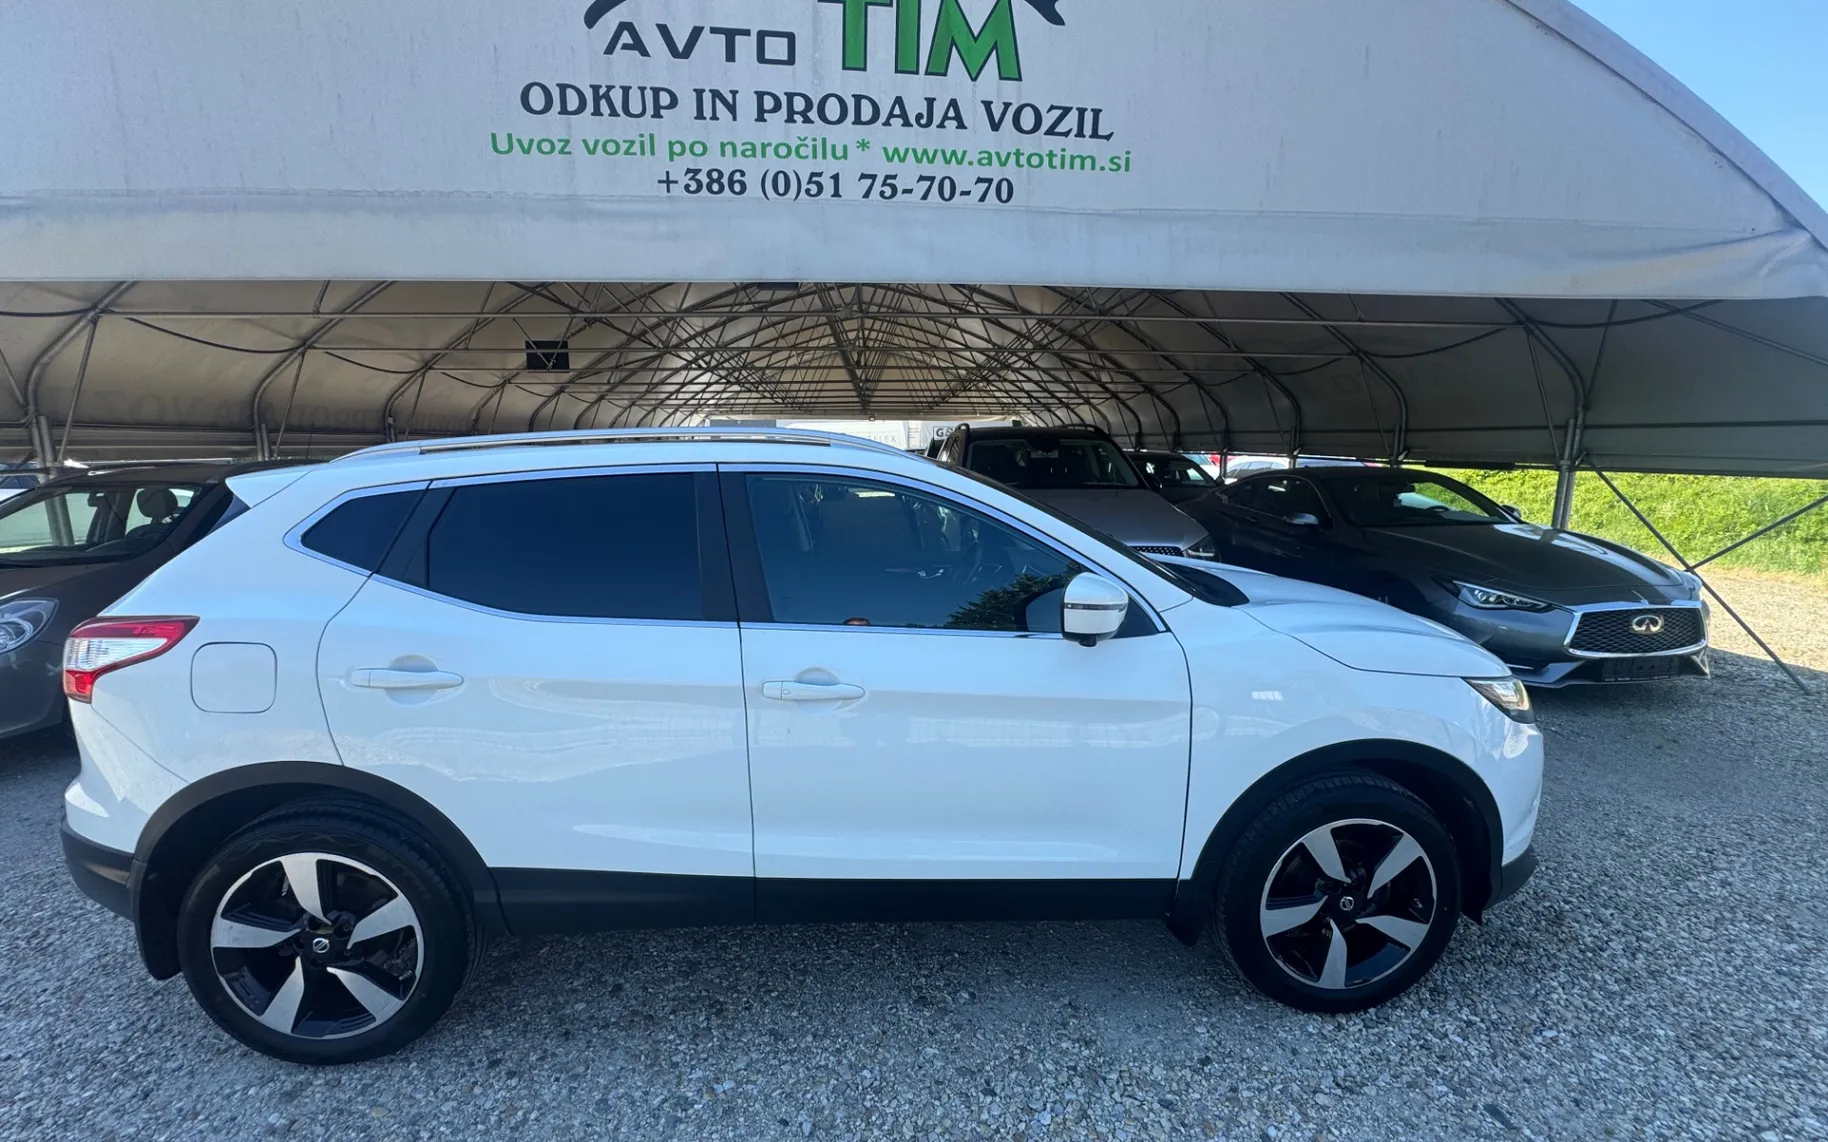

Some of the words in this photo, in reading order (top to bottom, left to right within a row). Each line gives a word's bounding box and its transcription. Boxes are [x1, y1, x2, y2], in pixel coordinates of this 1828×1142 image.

[603, 21, 796, 66] AVTO
[817, 0, 1022, 82] TIM
[520, 81, 679, 120] ODKUP
[693, 88, 740, 122] IN
[754, 91, 968, 131] PRODAJA
[980, 100, 1114, 141] VOZIL
[490, 132, 572, 157] Uvoz
[581, 132, 656, 158] vozil
[668, 139, 708, 162] po
[719, 136, 849, 161] naročilu
[883, 141, 1132, 173] www.avtotim.si
[657, 167, 748, 196] +386
[760, 168, 843, 202] (0)51
[858, 172, 1015, 204] 75-70-70
